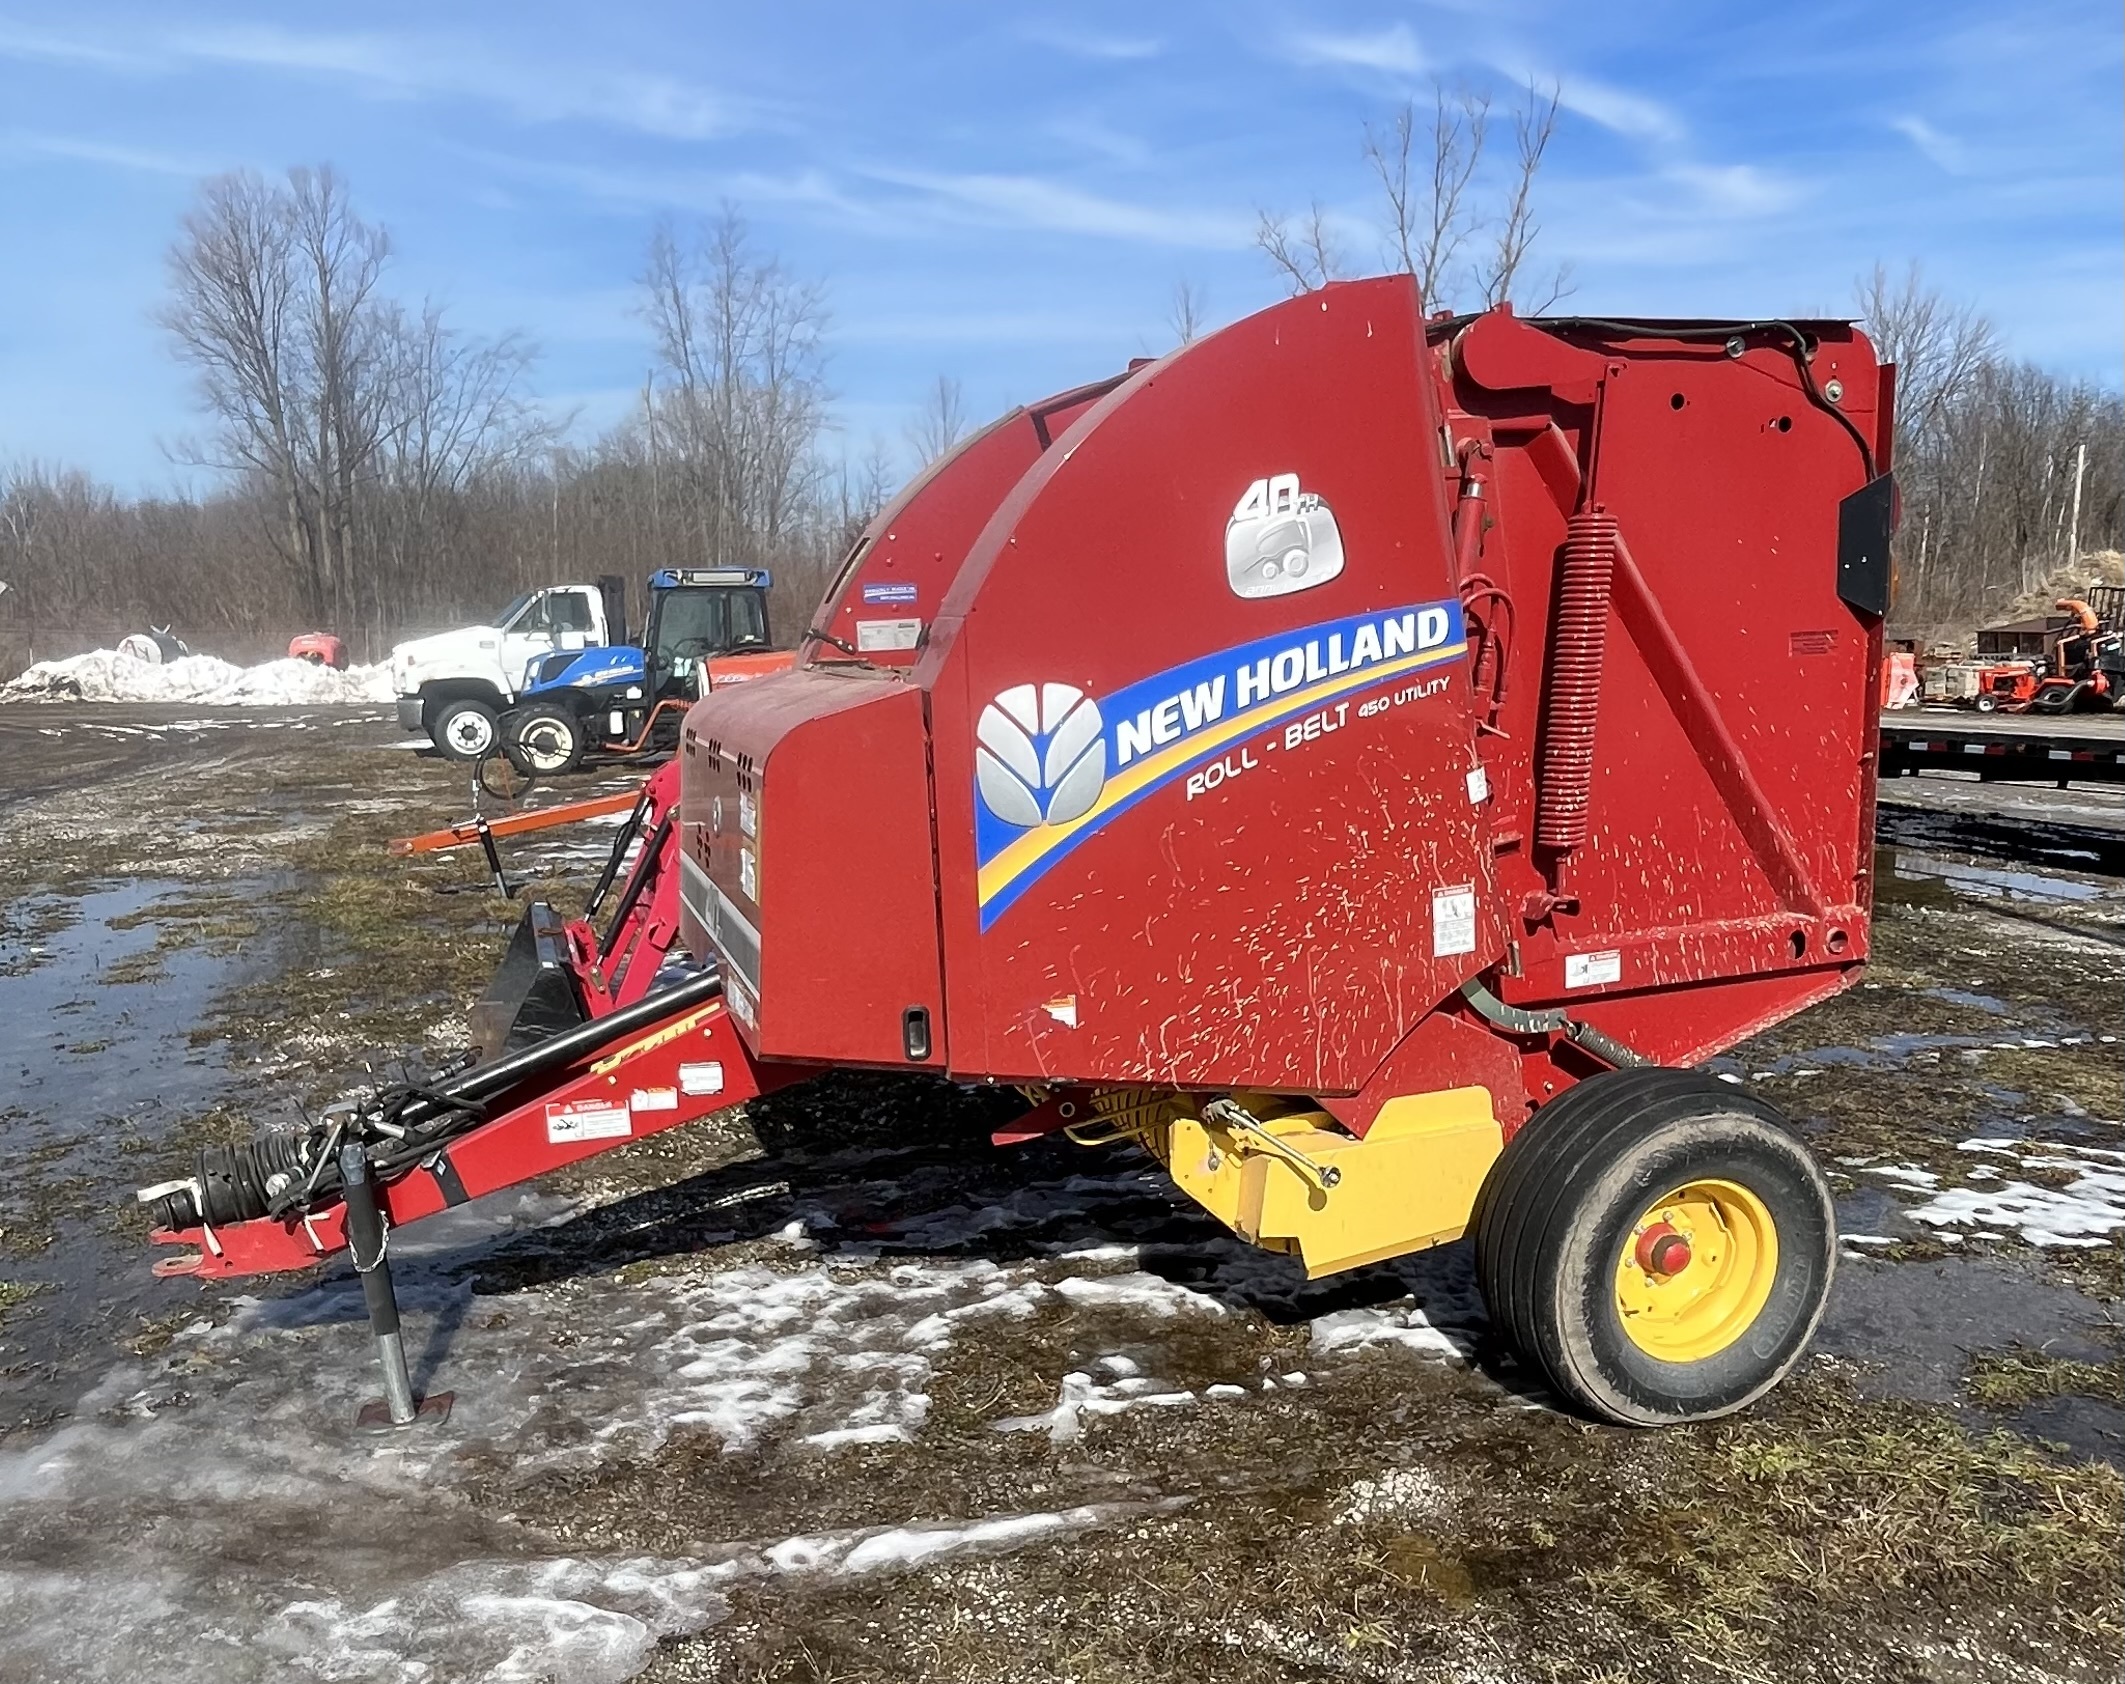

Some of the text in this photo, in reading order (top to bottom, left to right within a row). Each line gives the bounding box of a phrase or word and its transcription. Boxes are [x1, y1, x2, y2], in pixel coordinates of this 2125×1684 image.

[1116, 607, 1450, 766] NEW HOLLAND
[1186, 748, 1259, 801] ROLL
[1285, 702, 1350, 751] BELT
[1394, 676, 1451, 707] UTILITY
